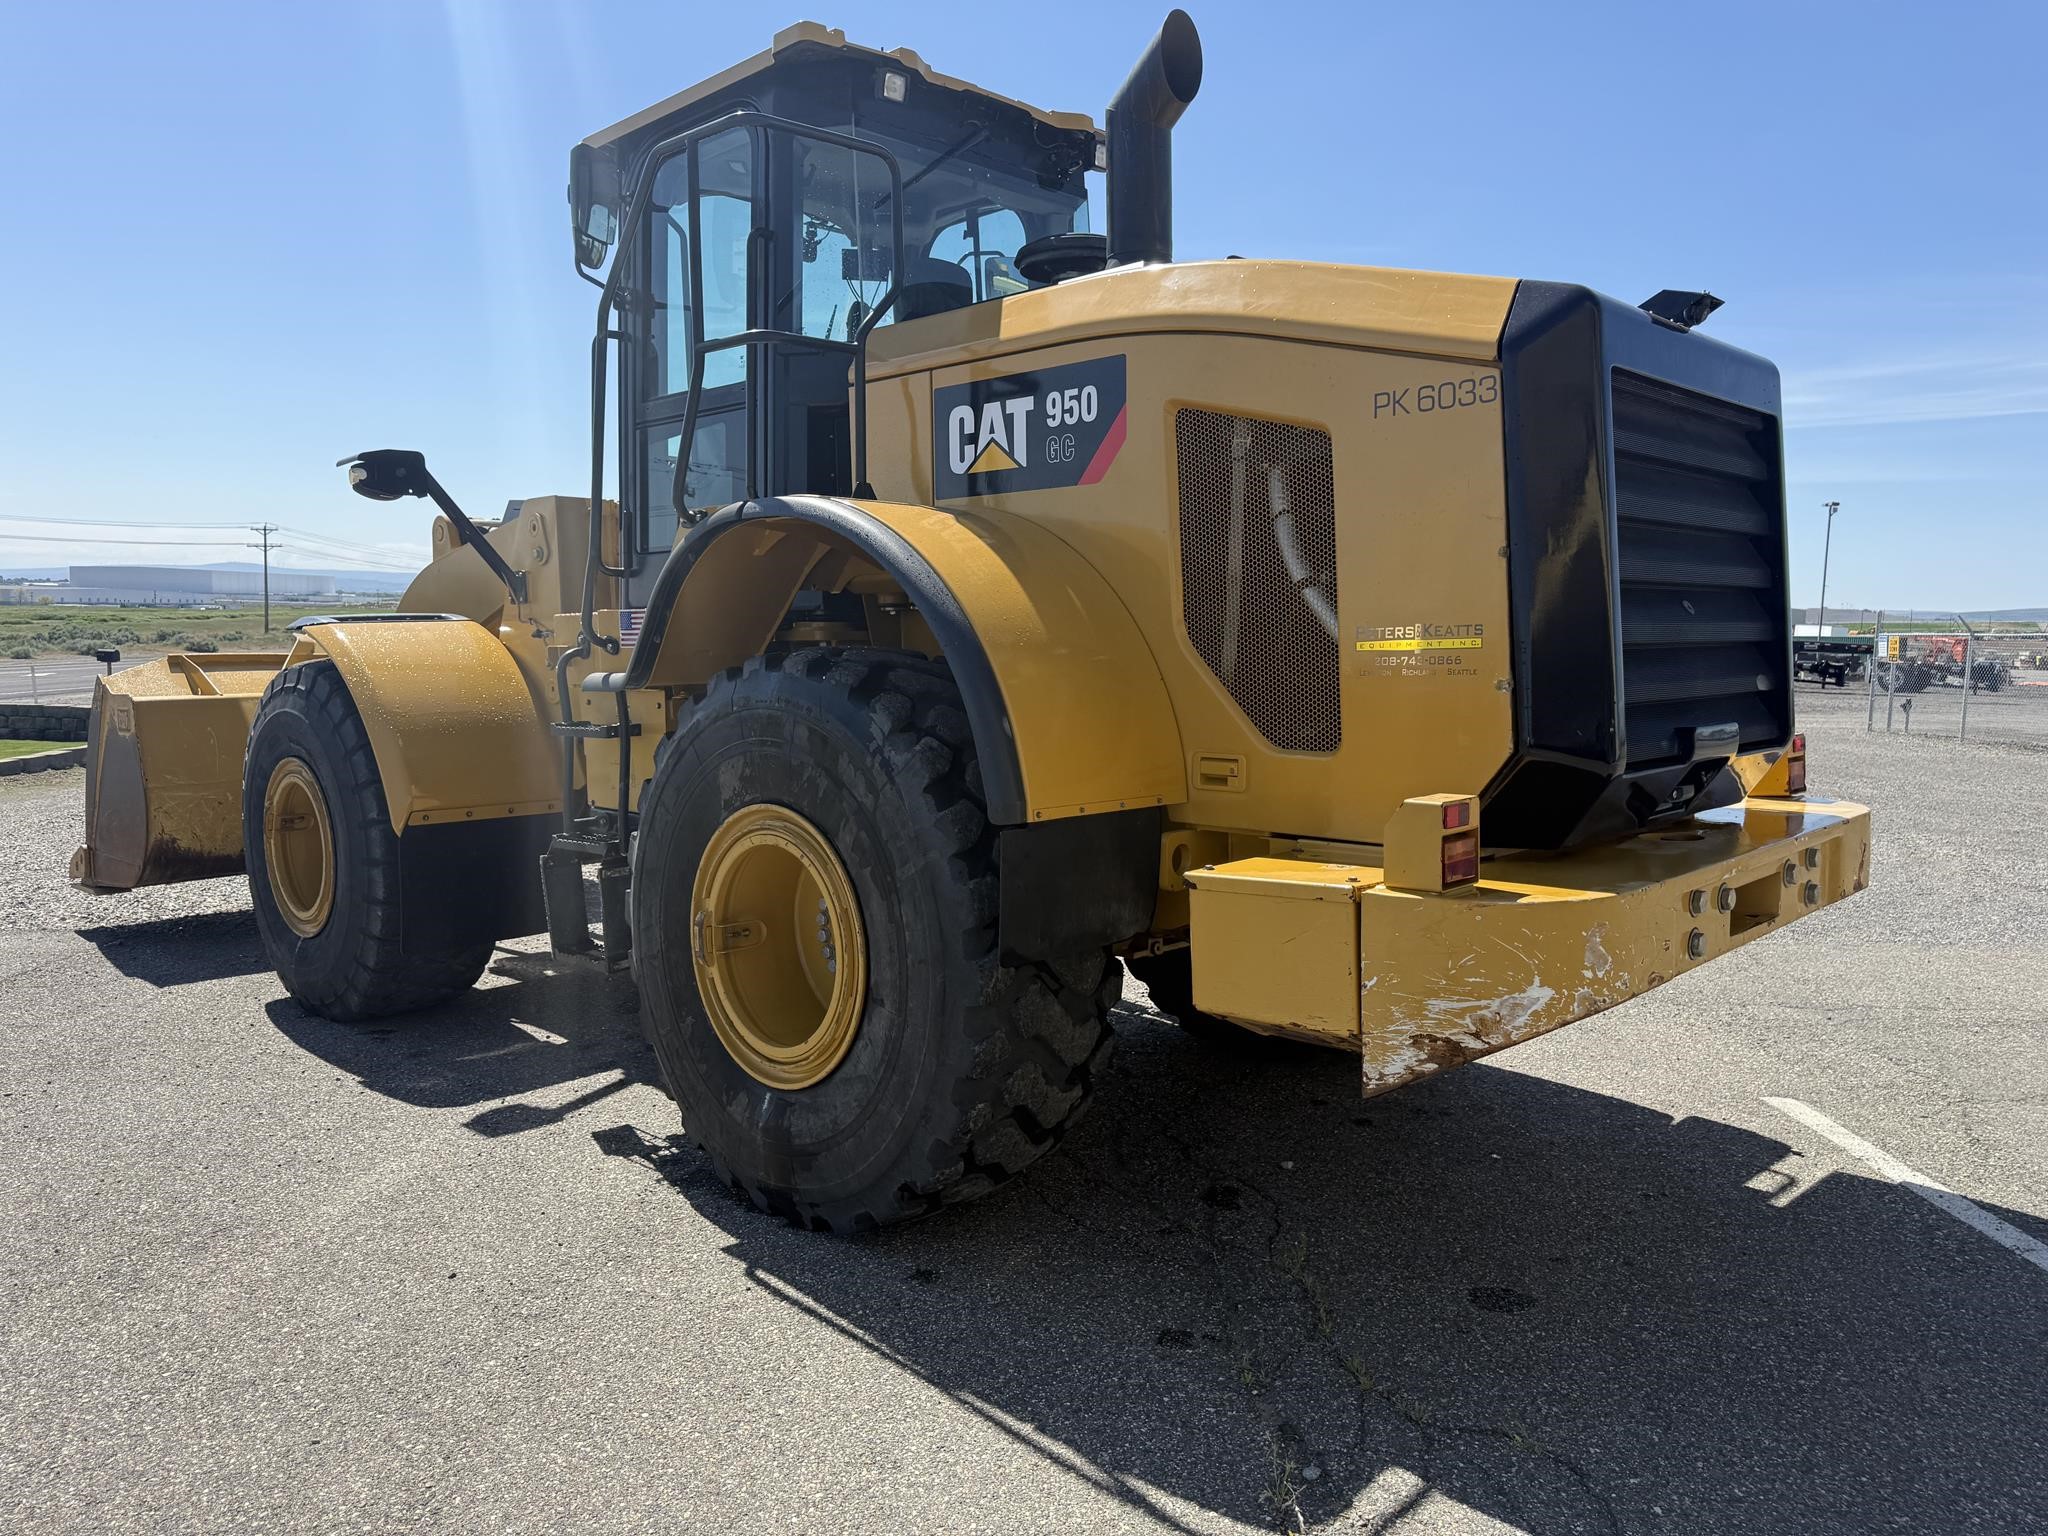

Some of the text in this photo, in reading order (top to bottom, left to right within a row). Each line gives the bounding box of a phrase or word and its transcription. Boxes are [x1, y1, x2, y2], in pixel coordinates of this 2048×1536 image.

[1374, 374, 1498, 419] PK 6033
[949, 385, 1098, 475] CAT 950
[1046, 433, 1075, 463] GC
[1360, 641, 1442, 649] EQUIPMENT
